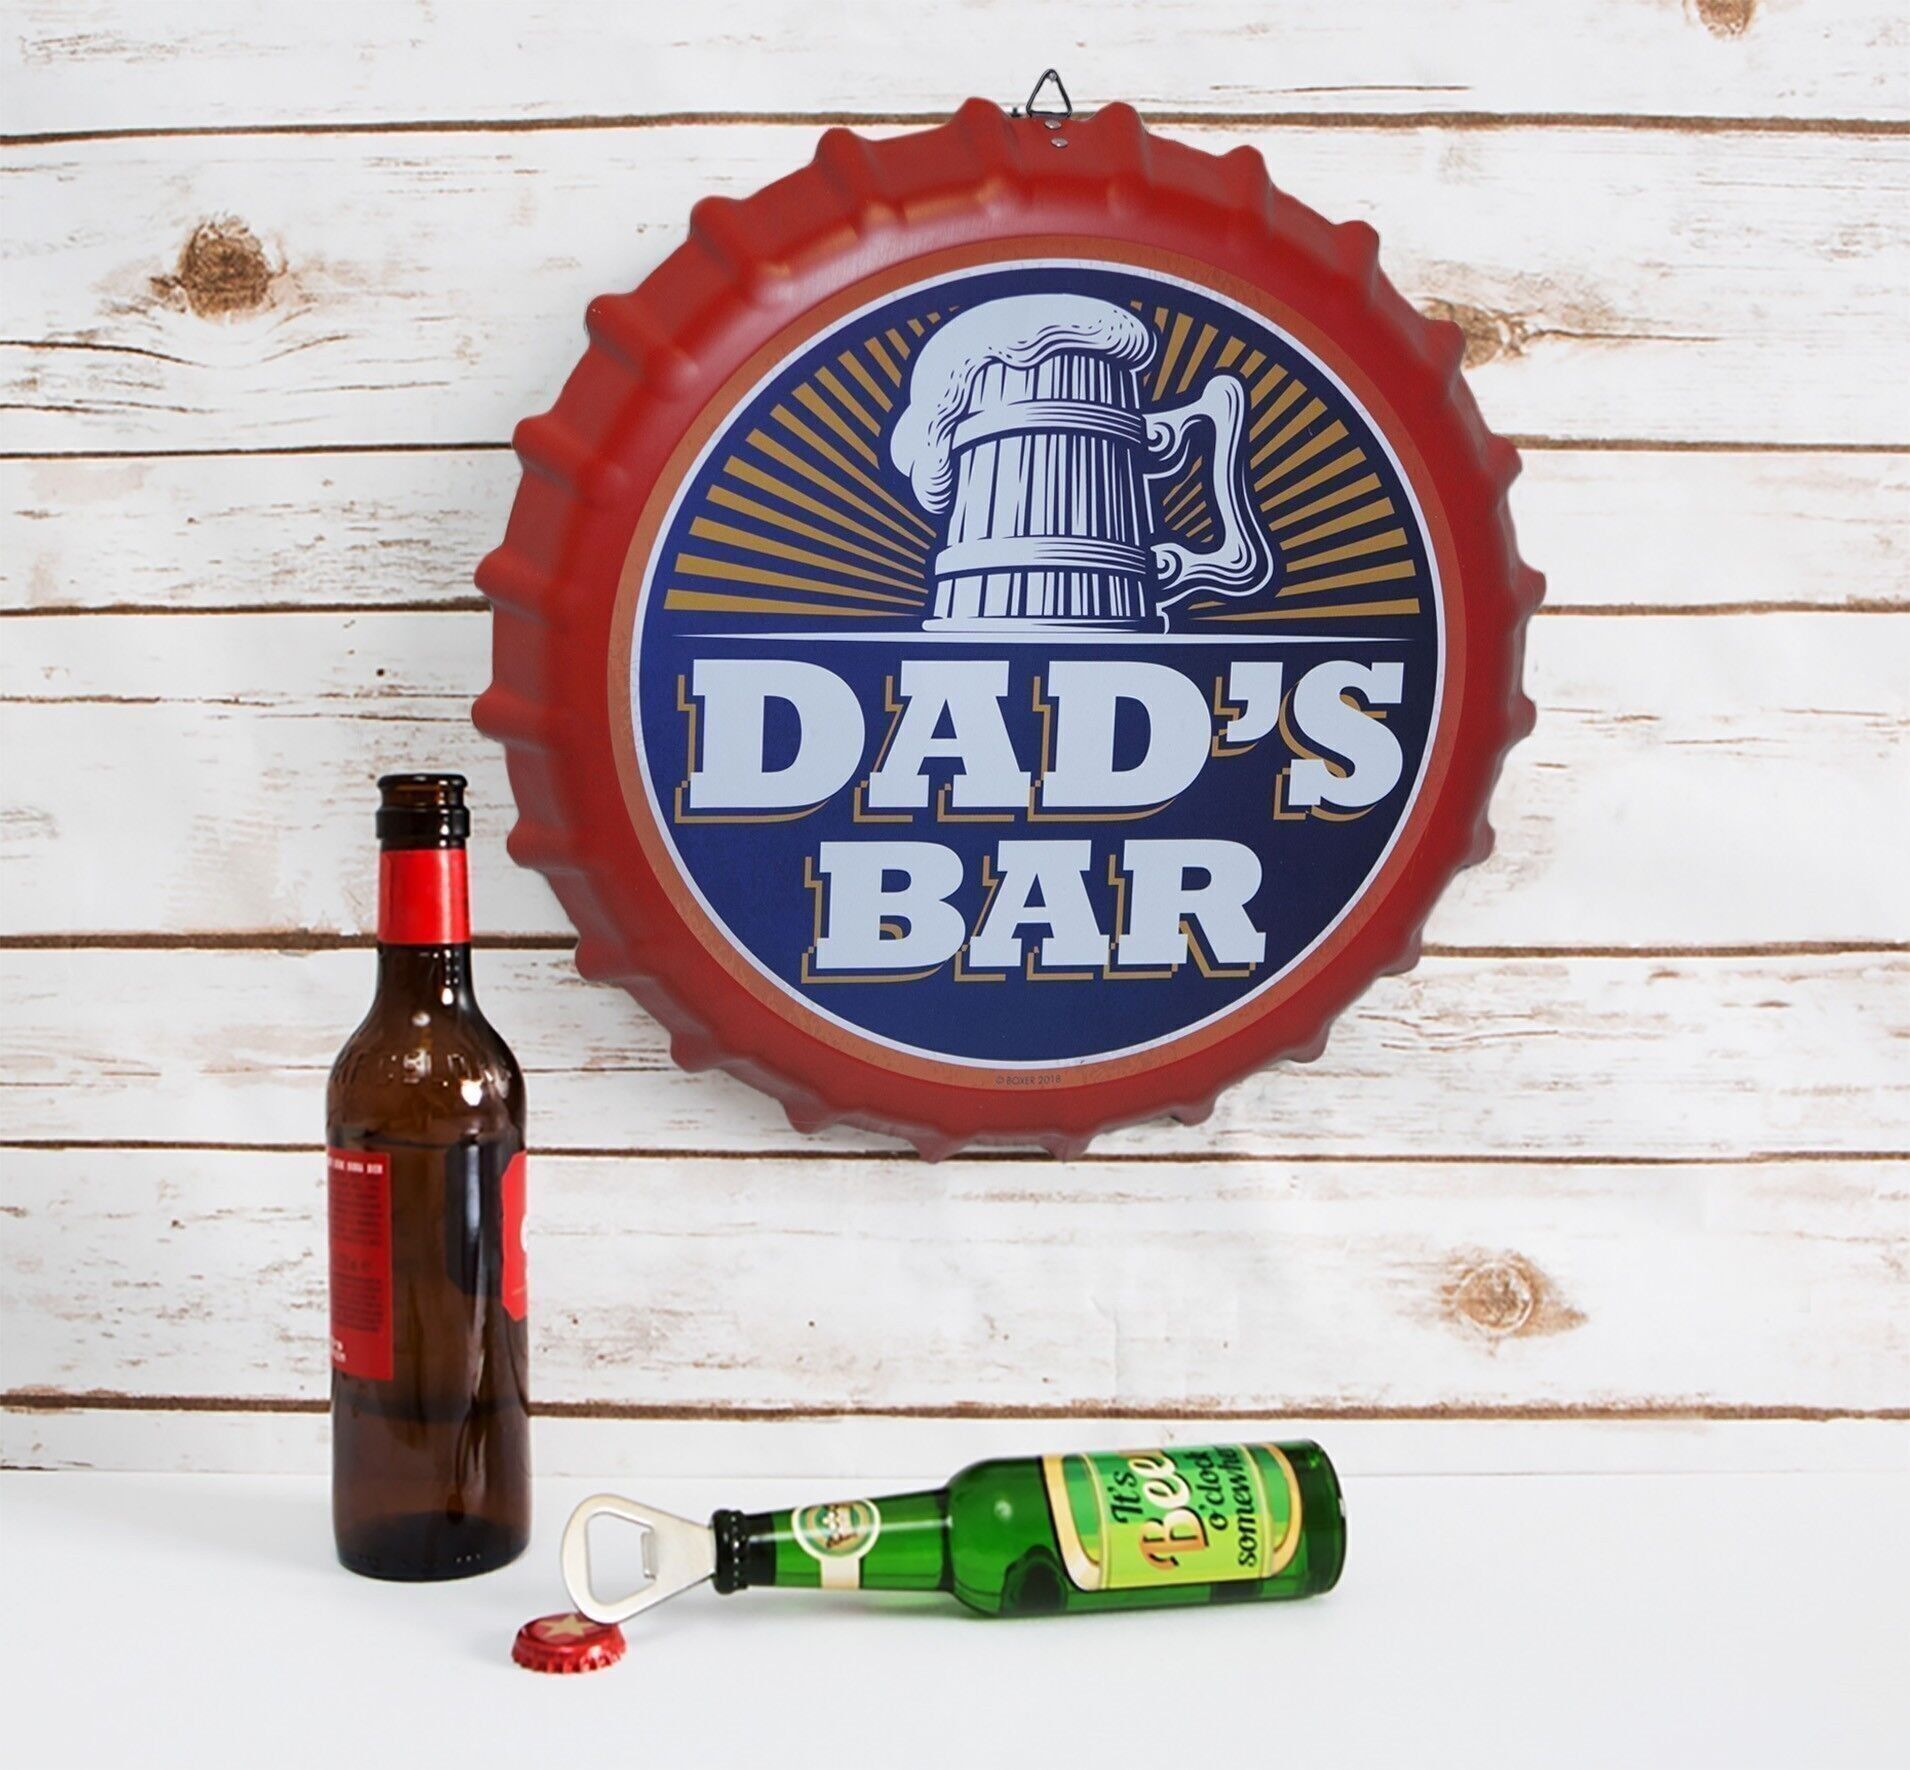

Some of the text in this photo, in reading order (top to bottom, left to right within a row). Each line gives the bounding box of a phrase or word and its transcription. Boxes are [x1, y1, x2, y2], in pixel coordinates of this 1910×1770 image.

[675, 660, 1404, 823] DAD'S
[801, 839, 1266, 984] BAR
[1006, 1076, 1036, 1086] BOXER
[1038, 1074, 1061, 1085] 2018
[1107, 1471, 1143, 1523] It's
[1128, 1450, 1209, 1572] Bee
